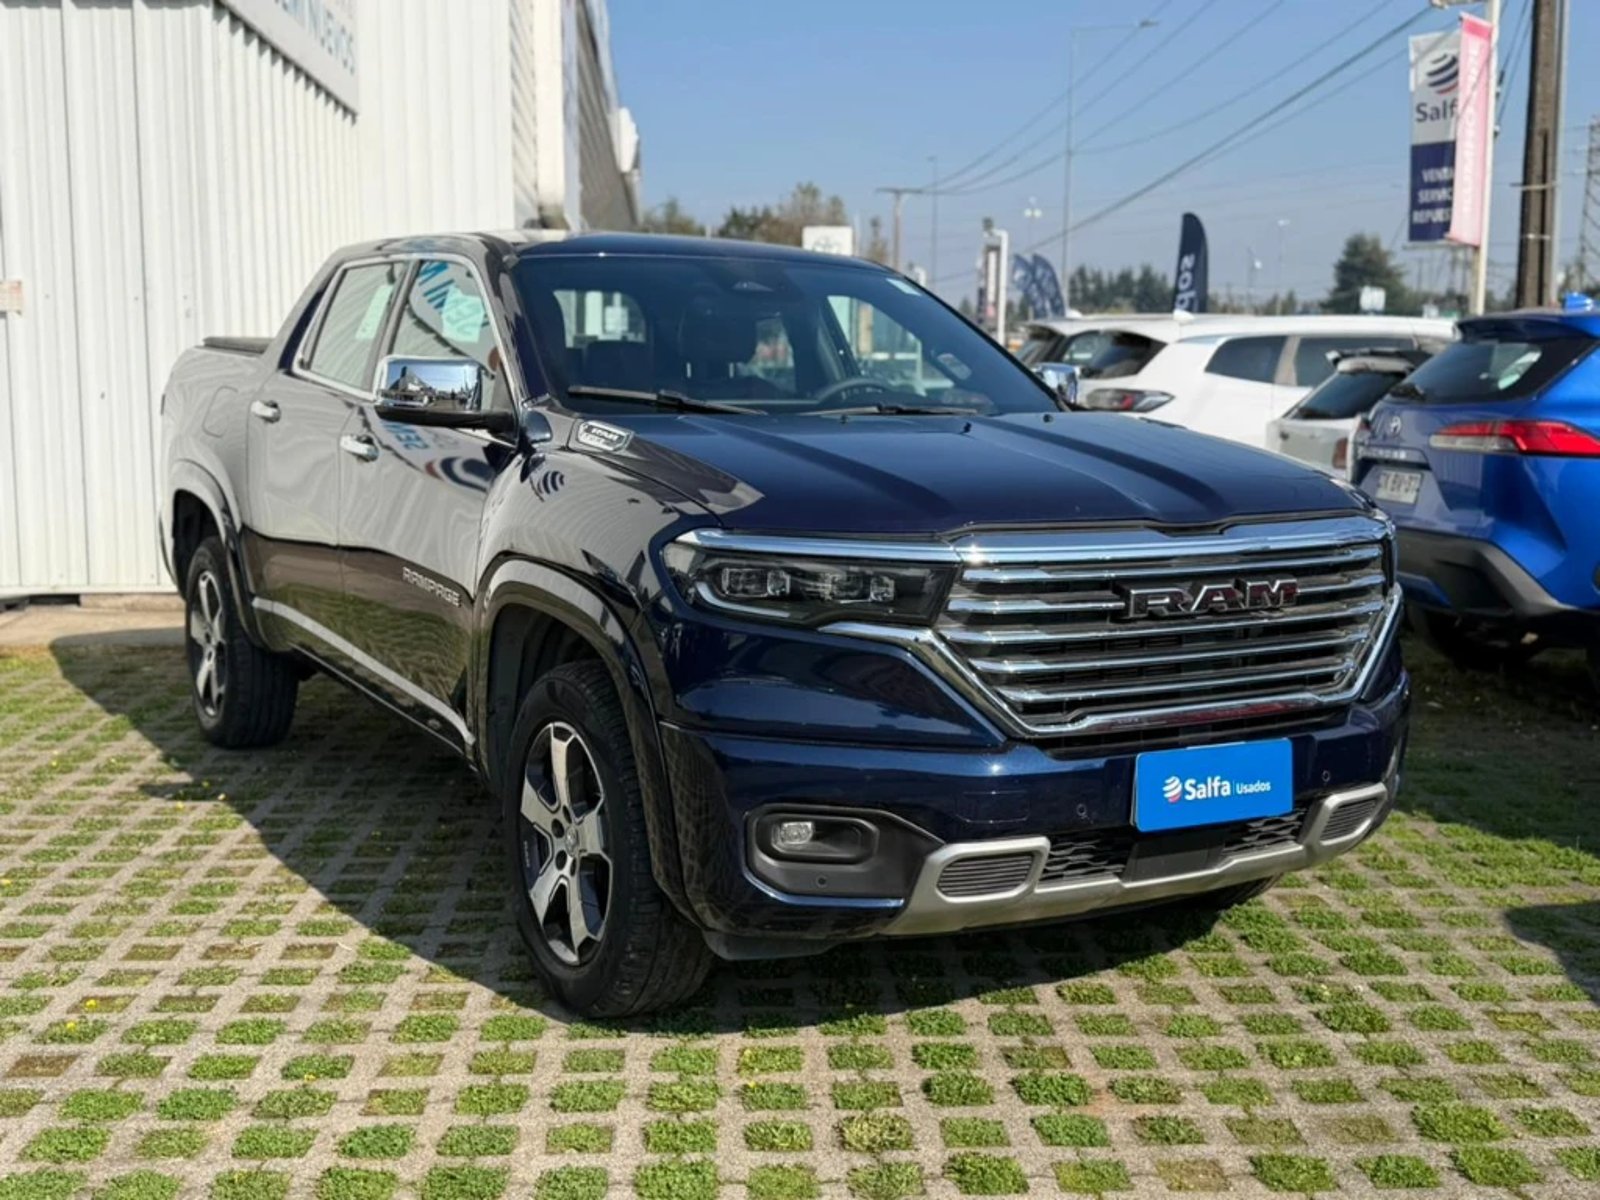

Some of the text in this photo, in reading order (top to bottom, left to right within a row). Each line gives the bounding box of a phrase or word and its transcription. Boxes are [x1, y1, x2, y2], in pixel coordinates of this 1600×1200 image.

[1415, 98, 1458, 123] Salf
[1418, 187, 1453, 204] SERVIC
[402, 565, 461, 609] RAMPAGE
[1124, 578, 1298, 619] RAM
[1184, 775, 1272, 801] Salfa Usados
